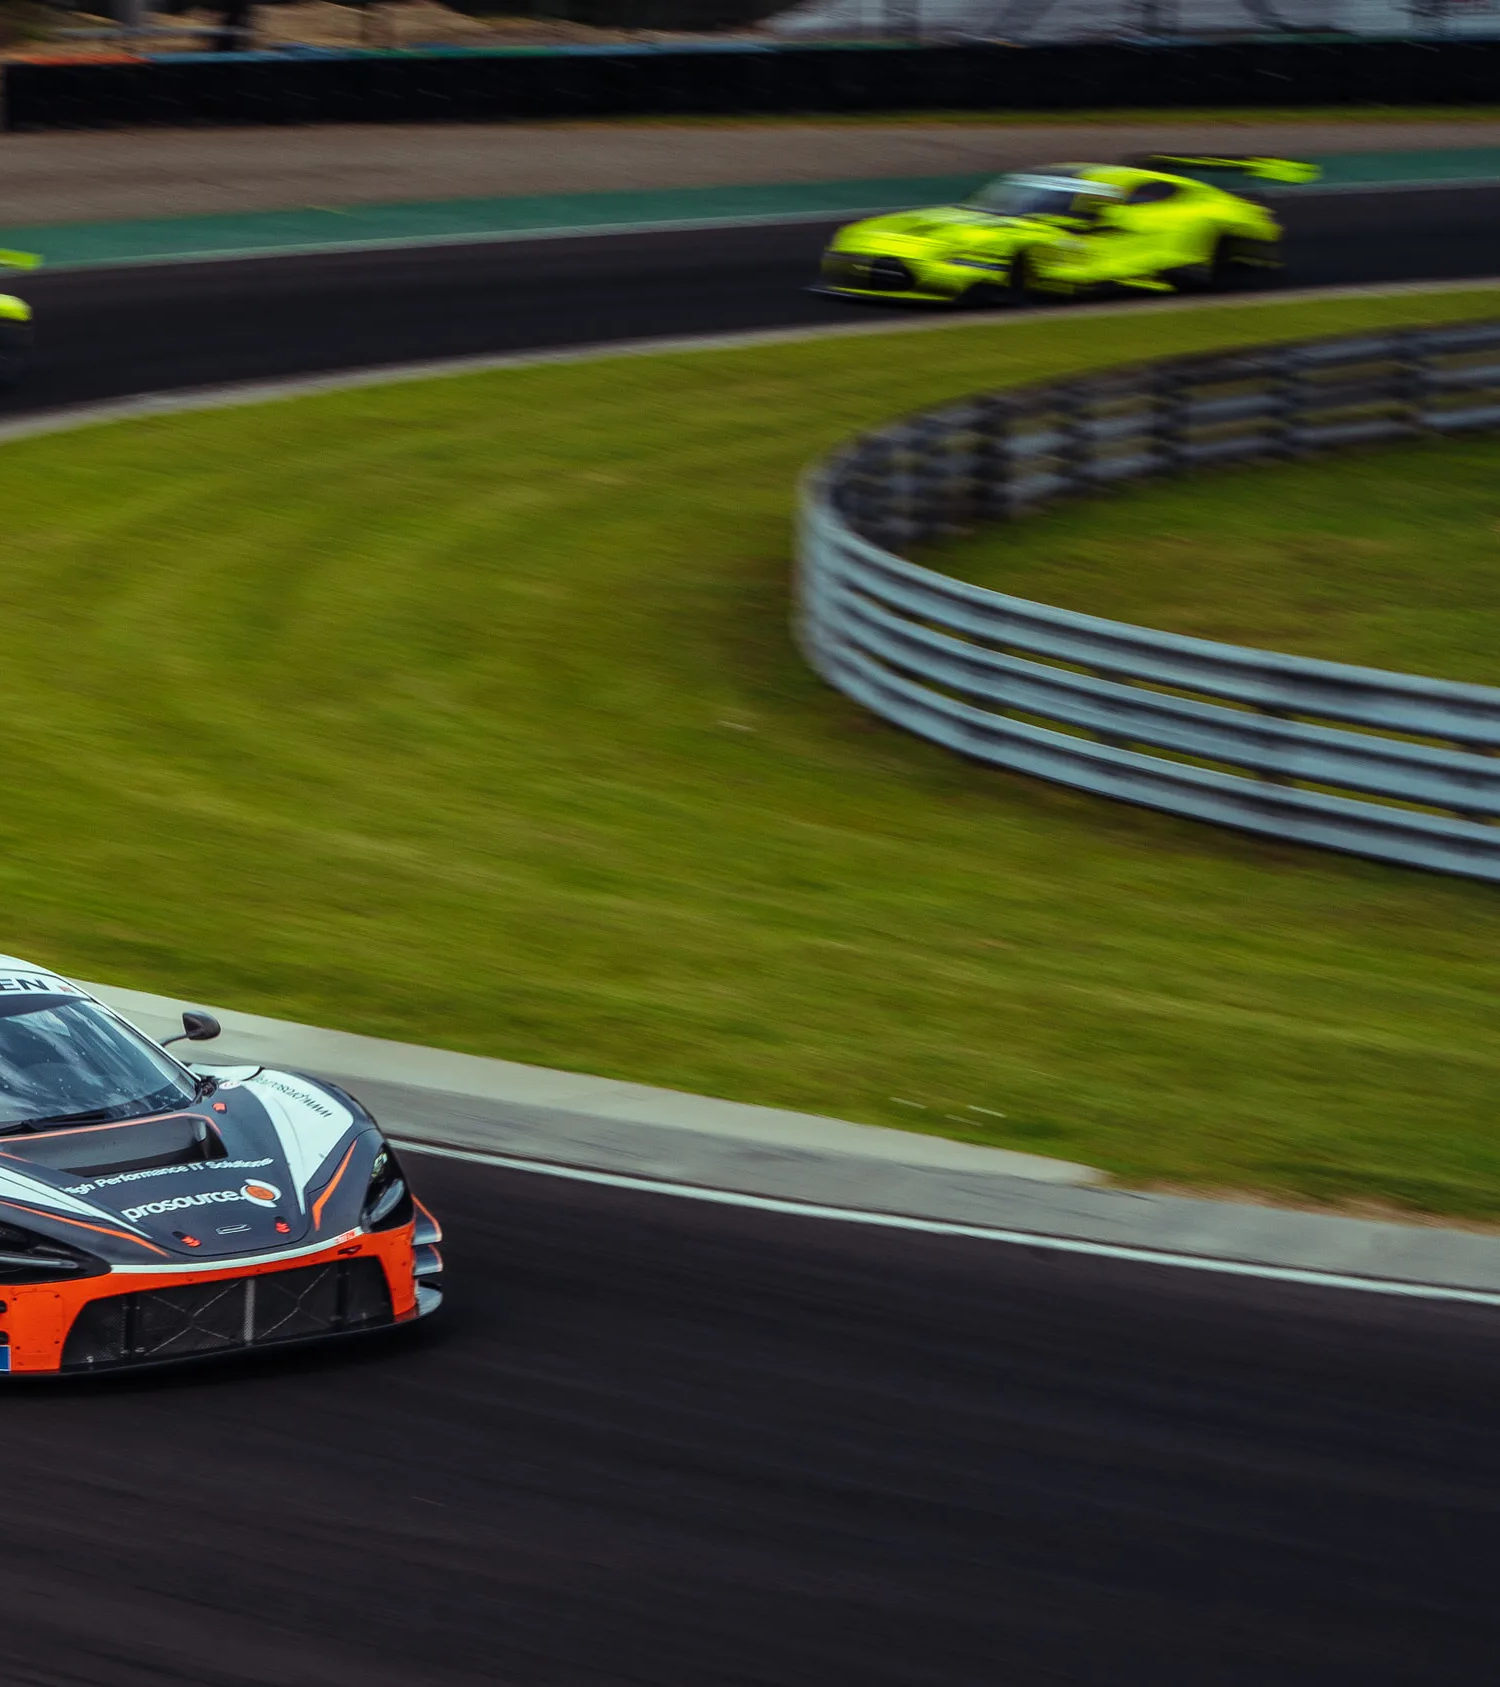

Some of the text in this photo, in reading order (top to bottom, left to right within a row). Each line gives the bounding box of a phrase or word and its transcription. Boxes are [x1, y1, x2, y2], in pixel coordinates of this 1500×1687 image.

[94, 1164, 189, 1187] Performance
[188, 1162, 204, 1172] IT
[206, 1158, 274, 1169] Solutions
